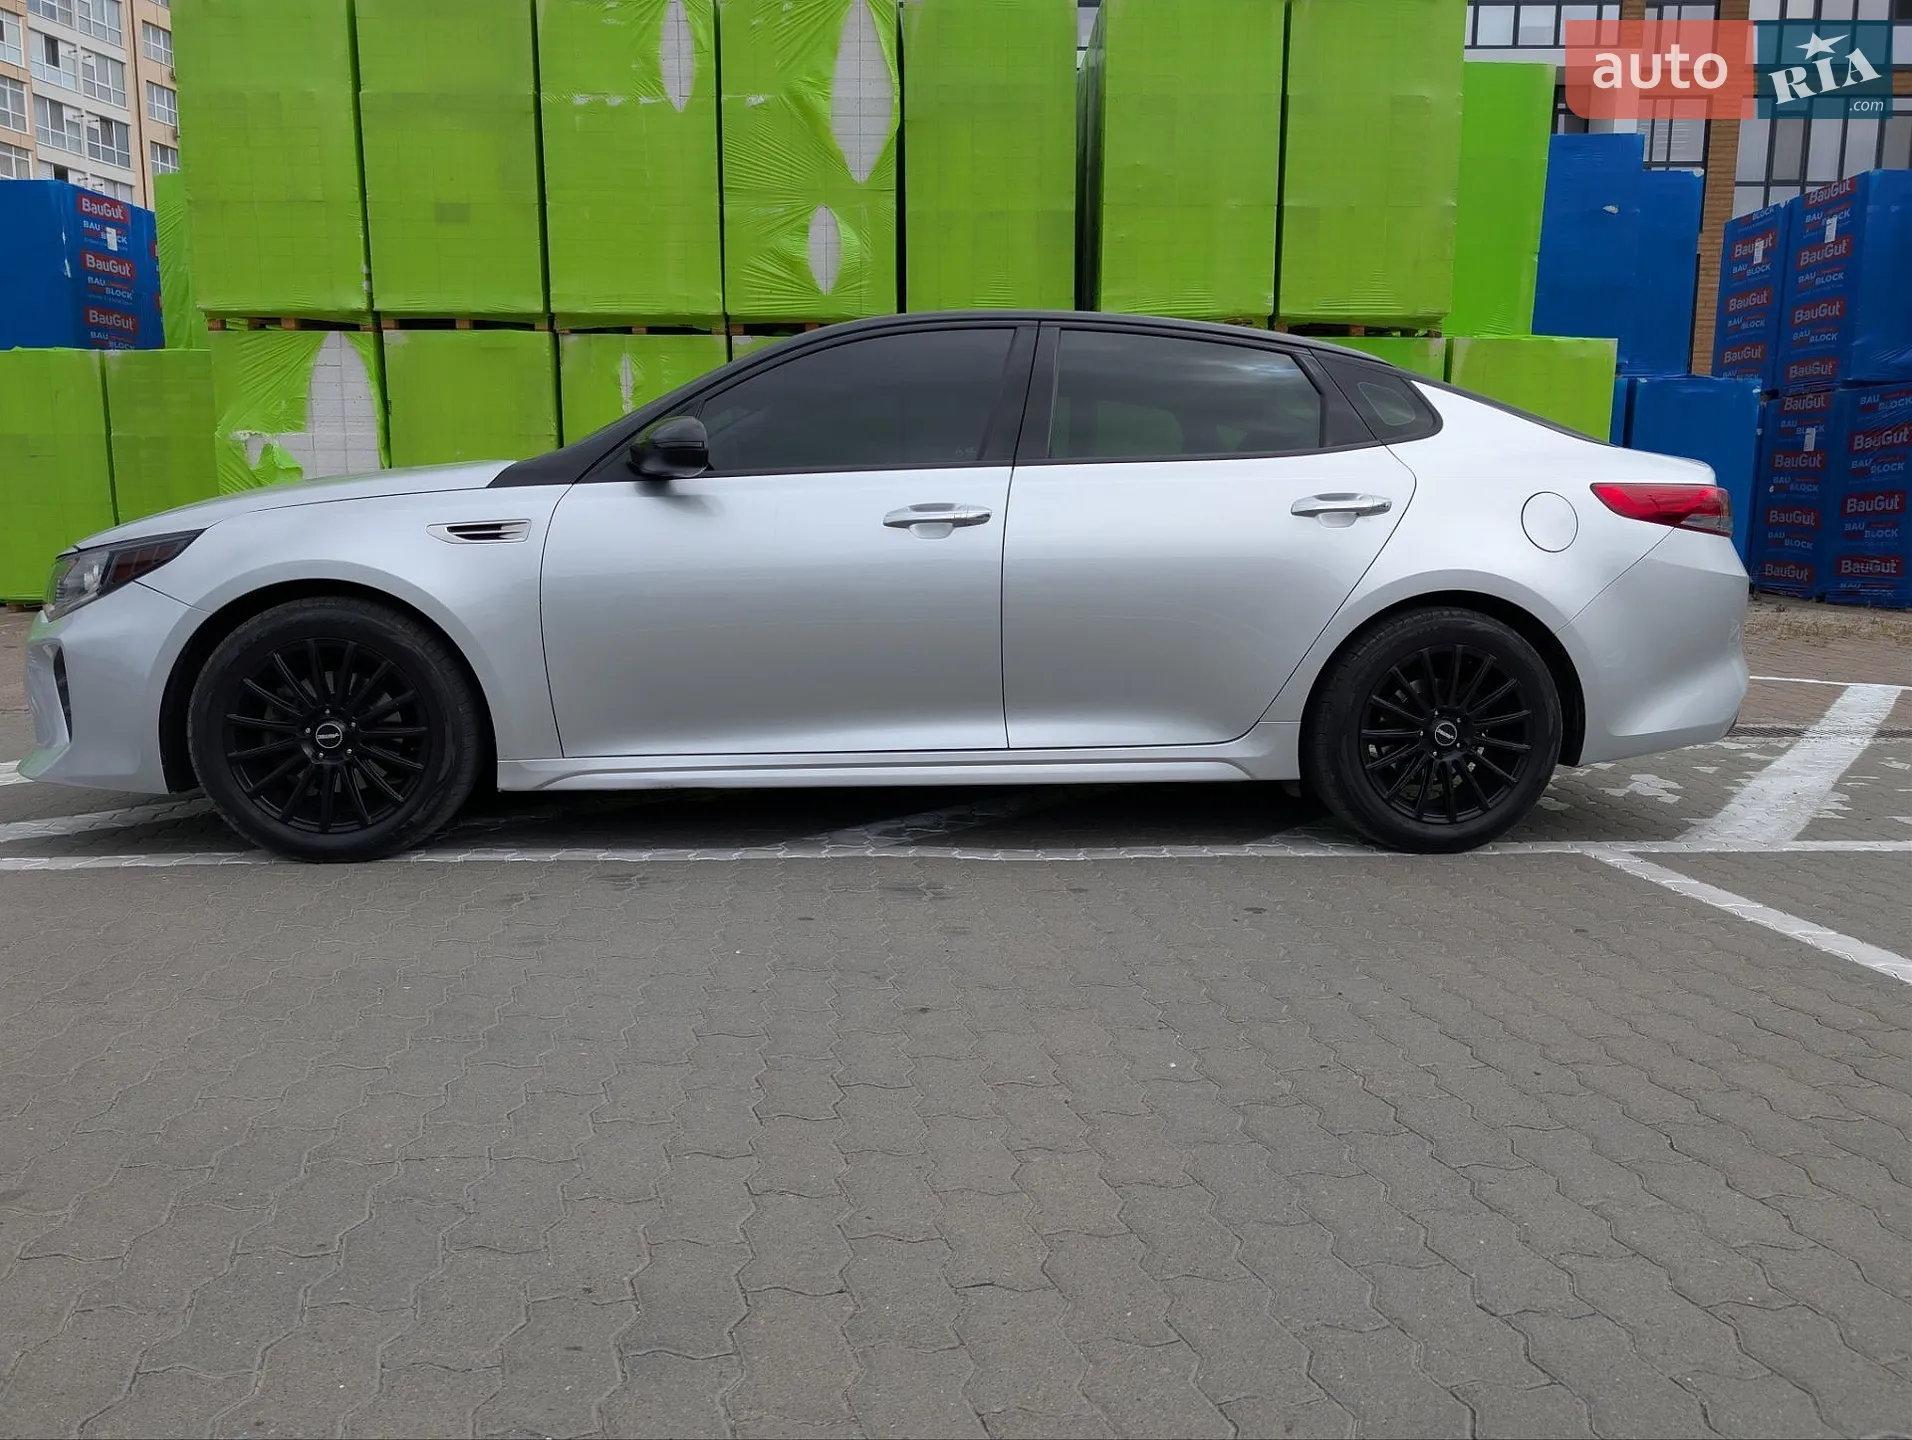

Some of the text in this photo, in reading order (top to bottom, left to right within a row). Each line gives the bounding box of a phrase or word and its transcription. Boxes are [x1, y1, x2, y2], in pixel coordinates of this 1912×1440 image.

[1808, 177, 1851, 205] BauGut
[82, 198, 124, 220] BauGut
[1805, 210, 1823, 223] BAU
[1821, 208, 1851, 226] BCK
[83, 220, 100, 231] BAU
[100, 231, 128, 245] BCK
[1799, 241, 1847, 267] BauGut
[85, 253, 131, 277] BauGut
[1732, 264, 1748, 274] BAU
[1746, 263, 1771, 276] BLOCK
[87, 276, 105, 286] BAU
[1798, 271, 1817, 284] BAU
[1815, 272, 1845, 286] BLOCK
[105, 287, 133, 300] BLOCK
[1728, 290, 1768, 312] BauGut
[89, 309, 134, 330] BauGut
[1794, 301, 1841, 325] BauGut
[1741, 319, 1765, 331] BLOCK
[90, 331, 109, 340] BAU
[1792, 329, 1810, 341] BAU
[1809, 332, 1838, 343] BLOCK
[1724, 345, 1761, 364] BauGut
[1789, 361, 1833, 379] BauGut
[1784, 394, 1826, 411] BauGut
[1853, 427, 1909, 451] BauGut
[1774, 453, 1822, 468] BauGut
[1851, 458, 1873, 469] BAU
[1870, 462, 1905, 474] BLOCK
[1772, 476, 1791, 484] BAU
[1789, 484, 1819, 492] BLOCK
[1846, 495, 1900, 513] BauGut
[1769, 510, 1816, 526] BauGut
[1845, 522, 1865, 531] BAU
[1864, 528, 1898, 538] BLOCK
[1784, 538, 1813, 549] BLOCK
[1764, 564, 1809, 581] BauGut
[1840, 559, 1897, 574] BauGut
